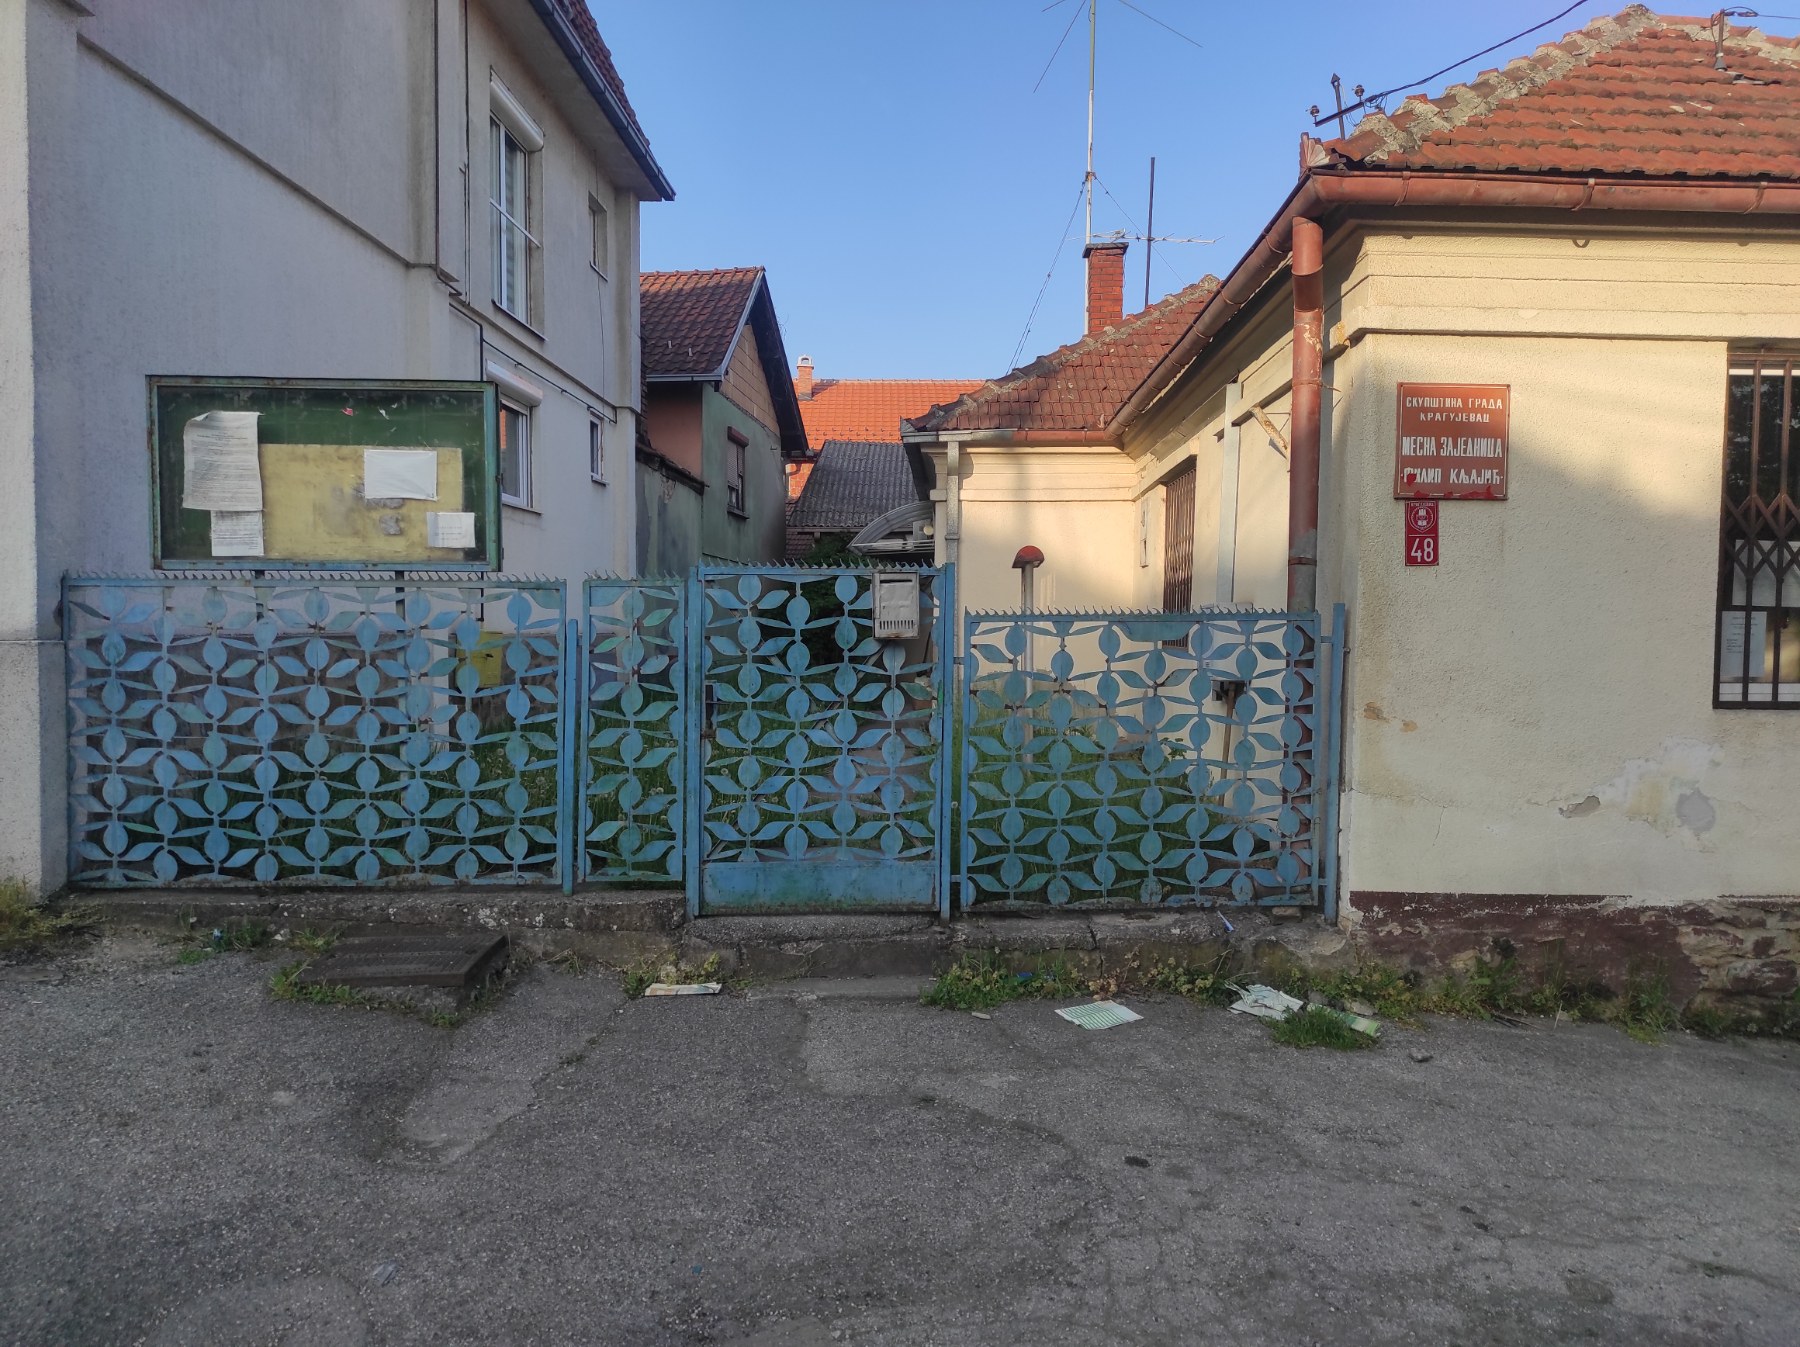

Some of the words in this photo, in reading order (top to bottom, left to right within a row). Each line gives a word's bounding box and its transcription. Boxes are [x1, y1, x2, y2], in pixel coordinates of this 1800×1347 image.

[1406, 397, 1463, 408] СКУПШТИНА
[1468, 398, 1503, 409] ГРАДА
[1420, 411, 1490, 423] КРАГУЈЕВАЦ
[1402, 436, 1437, 457] МЕСНА
[1440, 436, 1503, 458] ЗАЈЕДНИЦА
[1411, 537, 1434, 562] 48
